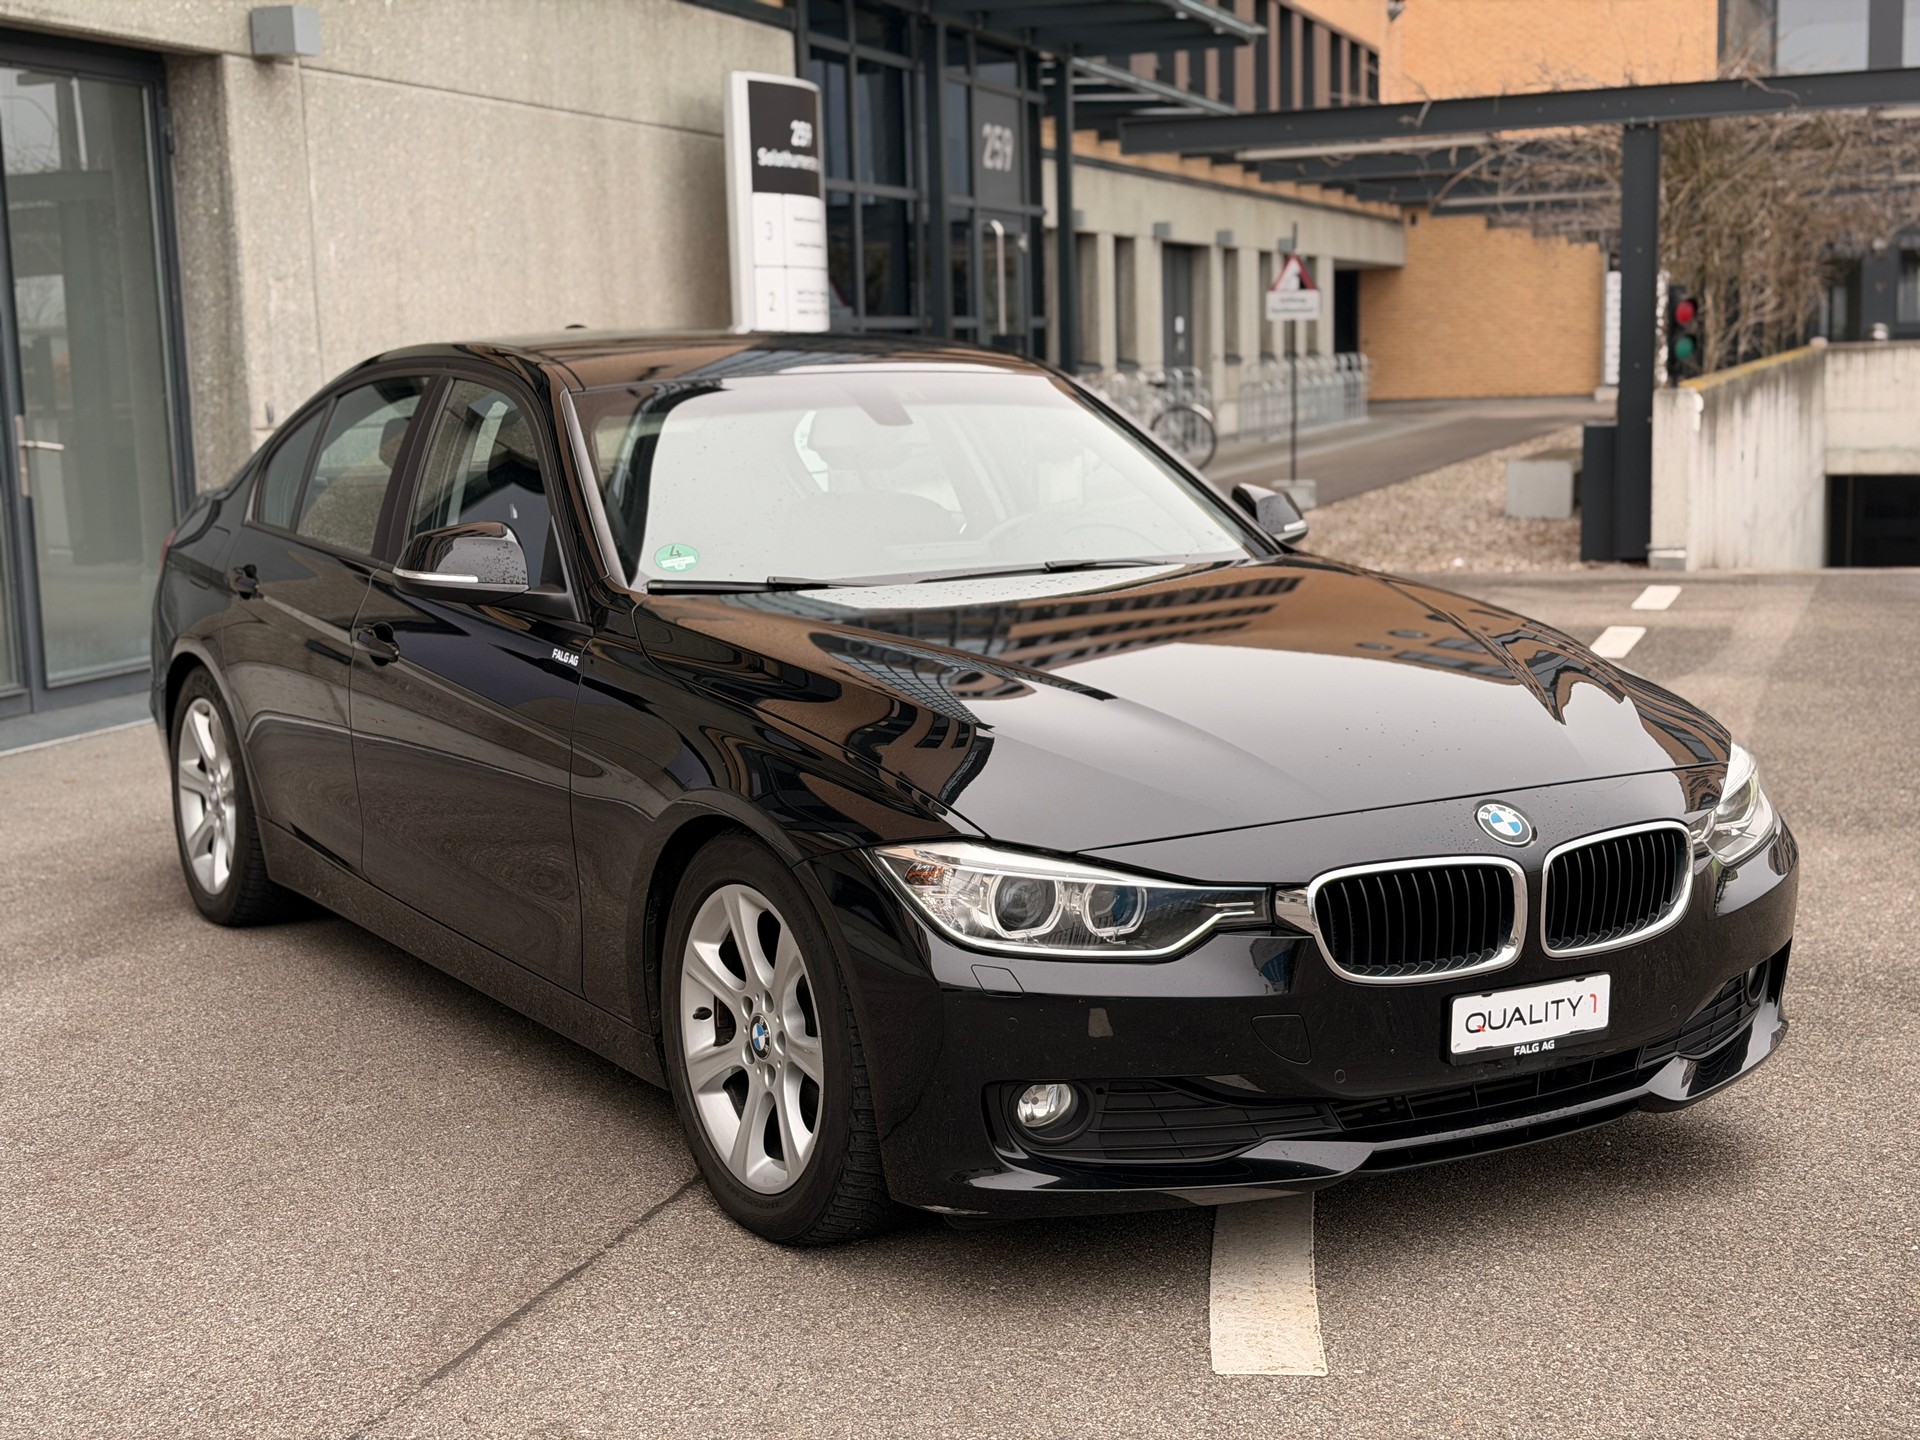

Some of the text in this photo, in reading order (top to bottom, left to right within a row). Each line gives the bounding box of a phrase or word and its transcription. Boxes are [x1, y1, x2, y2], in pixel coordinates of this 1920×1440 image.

[669, 545, 682, 557] 4
[552, 648, 579, 666] FALG AG
[1465, 995, 1583, 1033] QUALITY
[1513, 1040, 1555, 1056] FALG AG
